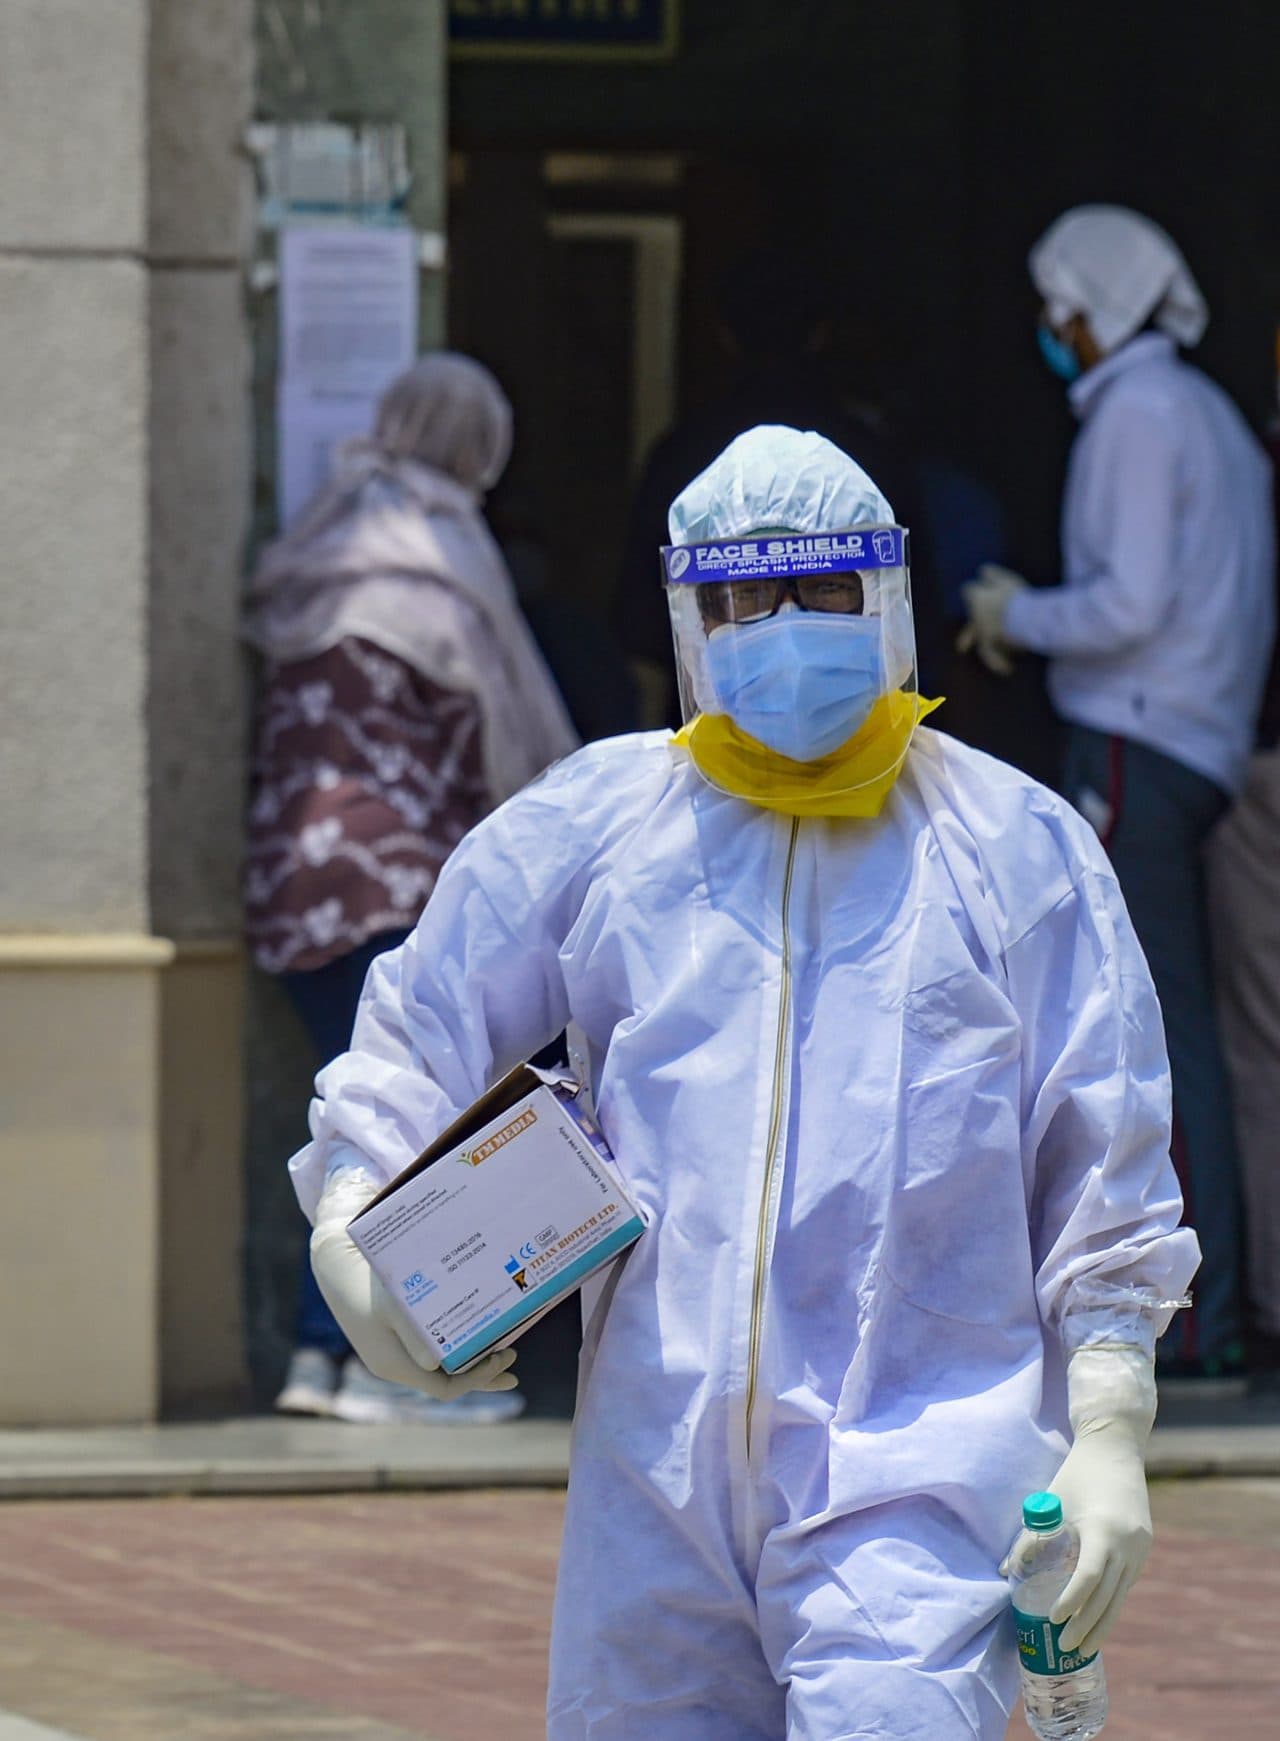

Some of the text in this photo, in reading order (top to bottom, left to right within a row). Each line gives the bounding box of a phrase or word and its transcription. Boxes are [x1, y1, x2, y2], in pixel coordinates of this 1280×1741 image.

[696, 535, 863, 560] FACE SHIELD
[697, 551, 865, 570] DIRECT SPLASH PROTECTION
[727, 561, 833, 577] MADE IN INDIA
[491, 1110, 536, 1147] MEDIA
[576, 1150, 601, 1183] Laboratory
[599, 1182, 609, 1194] For
[529, 1247, 558, 1269] TITAN
[557, 1217, 598, 1249] BIOTECH
[597, 1204, 618, 1220] LTD.
[538, 1229, 552, 1242] GMP
[440, 1254, 452, 1264] ISO
[519, 1242, 537, 1260] CE
[448, 1263, 458, 1272] ISO
[402, 1271, 423, 1291] IVD
